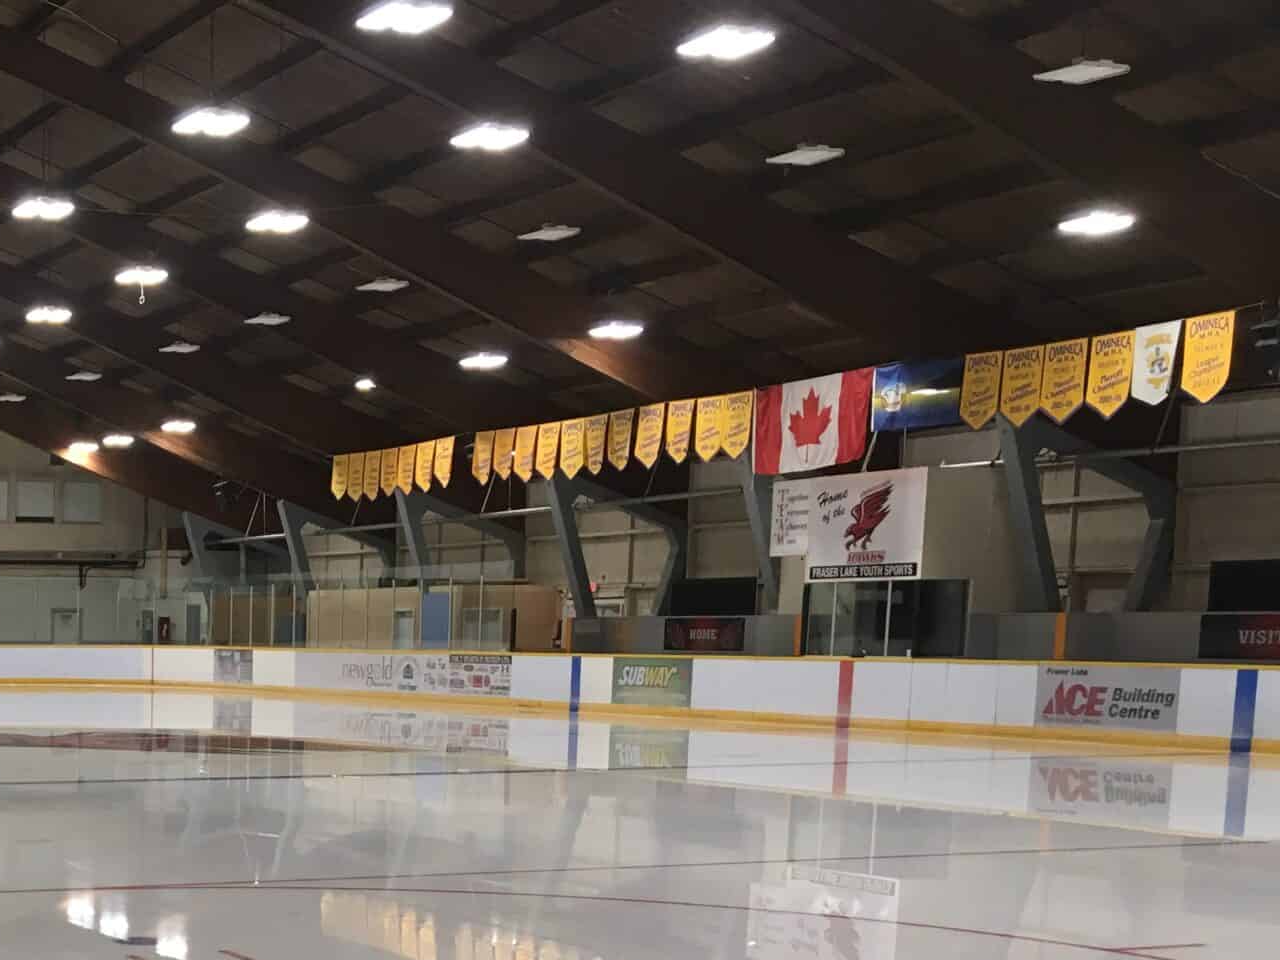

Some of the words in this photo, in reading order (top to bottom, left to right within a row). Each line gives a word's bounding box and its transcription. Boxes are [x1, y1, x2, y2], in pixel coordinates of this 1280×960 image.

[1190, 316, 1230, 338] OMINECA
[1096, 335, 1131, 355] OMINECA
[817, 488, 849, 507] Home
[822, 510, 832, 525] of
[833, 504, 846, 518] the
[812, 567, 839, 578] FRASER
[840, 567, 858, 577] LAKE
[860, 566, 884, 577] YOUTH
[884, 565, 913, 576] SPORTS
[688, 628, 718, 640] HOME
[618, 666, 677, 688] SUBWAY
[1041, 680, 1108, 717] ACE
[1111, 687, 1176, 708] Building
[1108, 704, 1161, 721] Centre
